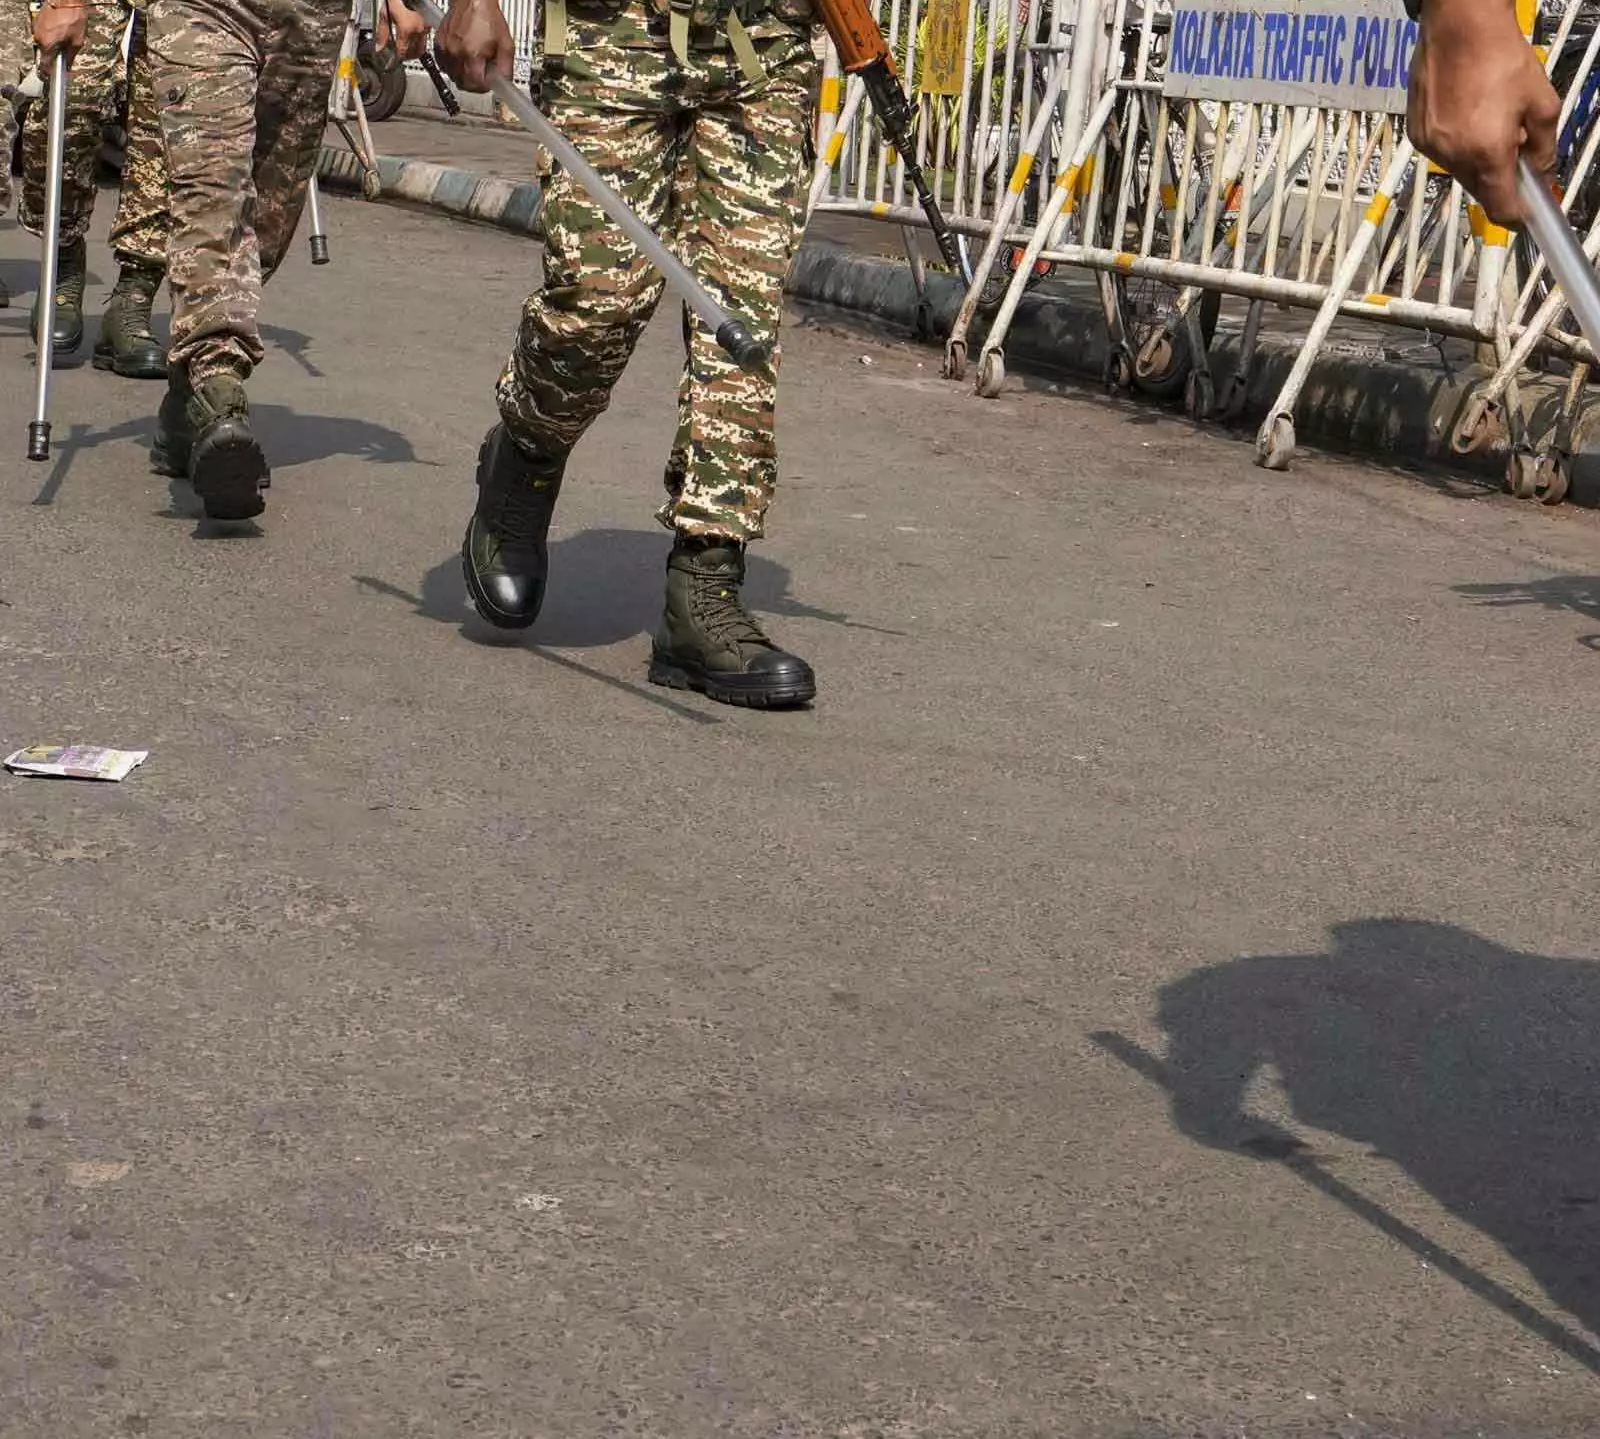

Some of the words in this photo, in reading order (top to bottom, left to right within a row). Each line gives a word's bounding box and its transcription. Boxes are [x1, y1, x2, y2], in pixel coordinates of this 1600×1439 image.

[1170, 9, 1257, 79] KOLKATA
[1262, 12, 1347, 86] TRAFFIC
[1349, 16, 1421, 90] POLIC
